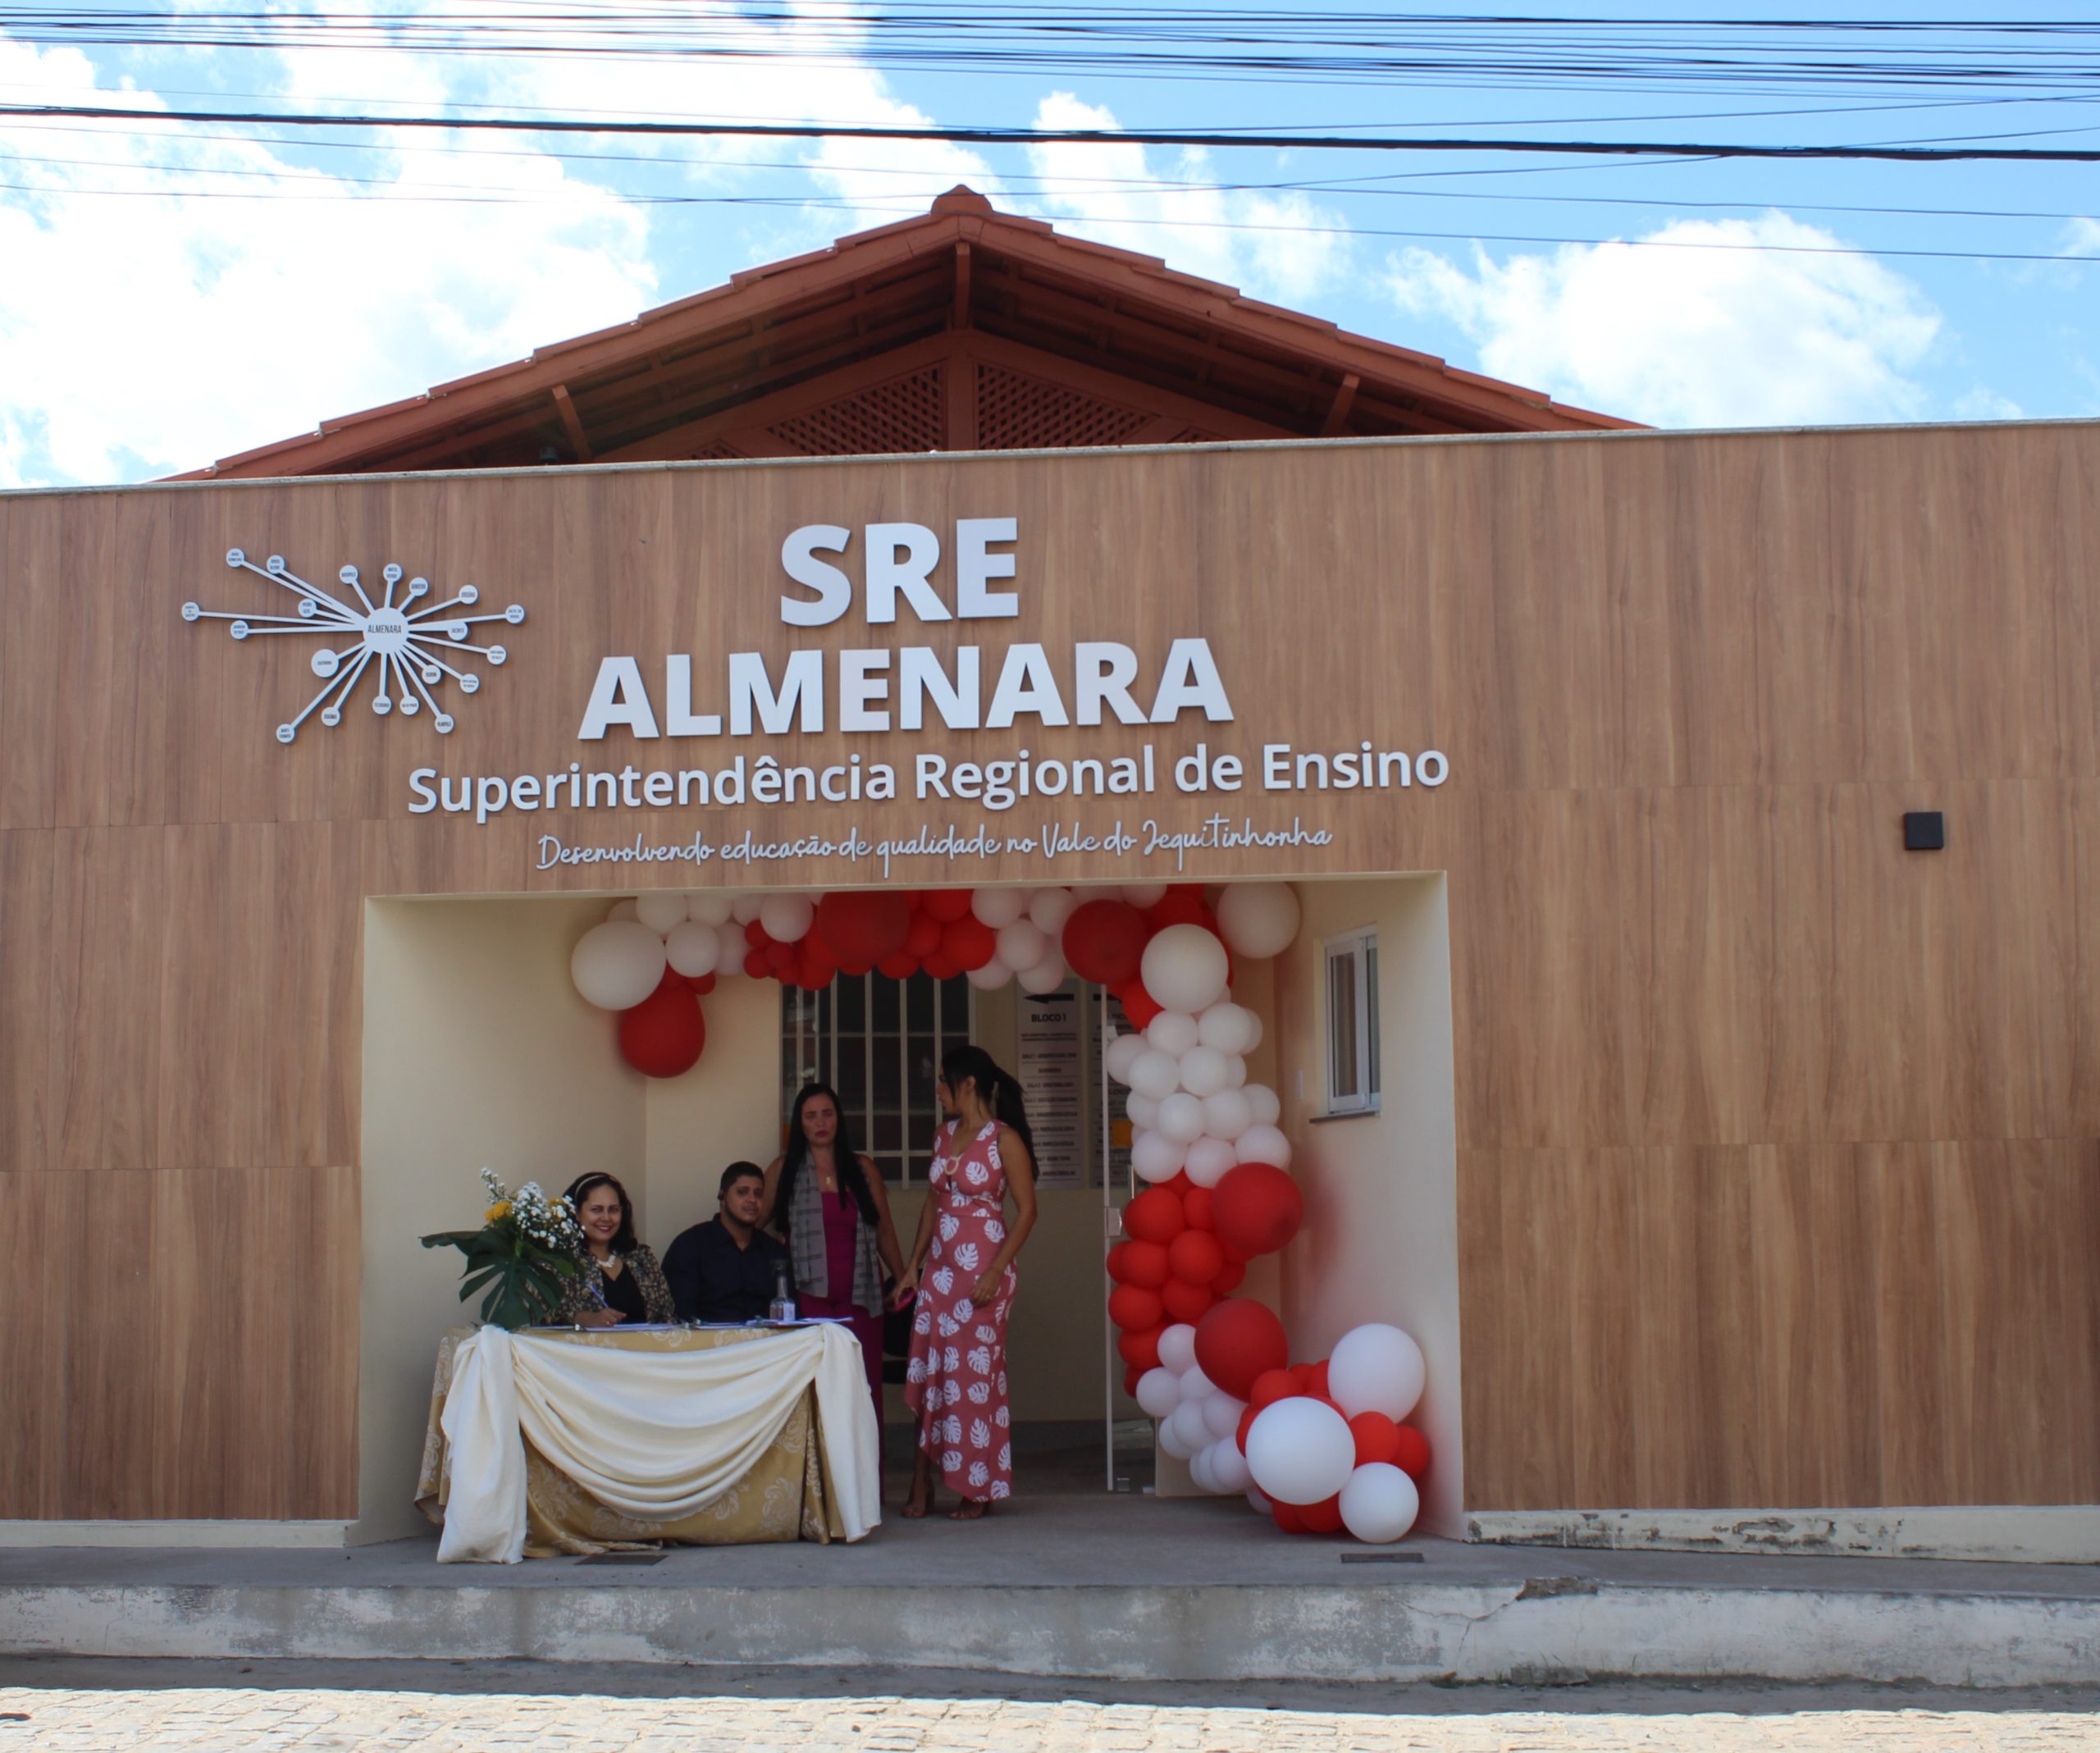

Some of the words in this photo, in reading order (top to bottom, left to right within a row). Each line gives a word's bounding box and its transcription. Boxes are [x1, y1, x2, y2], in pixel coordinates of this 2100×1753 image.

[780, 516, 1020, 627] SRE
[368, 624, 402, 633] ALMENARA
[577, 637, 1235, 741] ALMENARA
[409, 753, 895, 824] Superintendência
[915, 744, 1155, 811] Regional
[1175, 742, 1244, 792] de
[1263, 741, 1449, 789] Ensino
[536, 830, 715, 870] Desenvolvendo
[720, 829, 838, 865] educação
[838, 826, 874, 862] de
[876, 823, 1002, 879] qualidade
[1007, 838, 1038, 854] no
[1042, 822, 1102, 859] Vale
[1103, 820, 1137, 856] do
[1031, 1013, 1061, 1022] BLOCO
